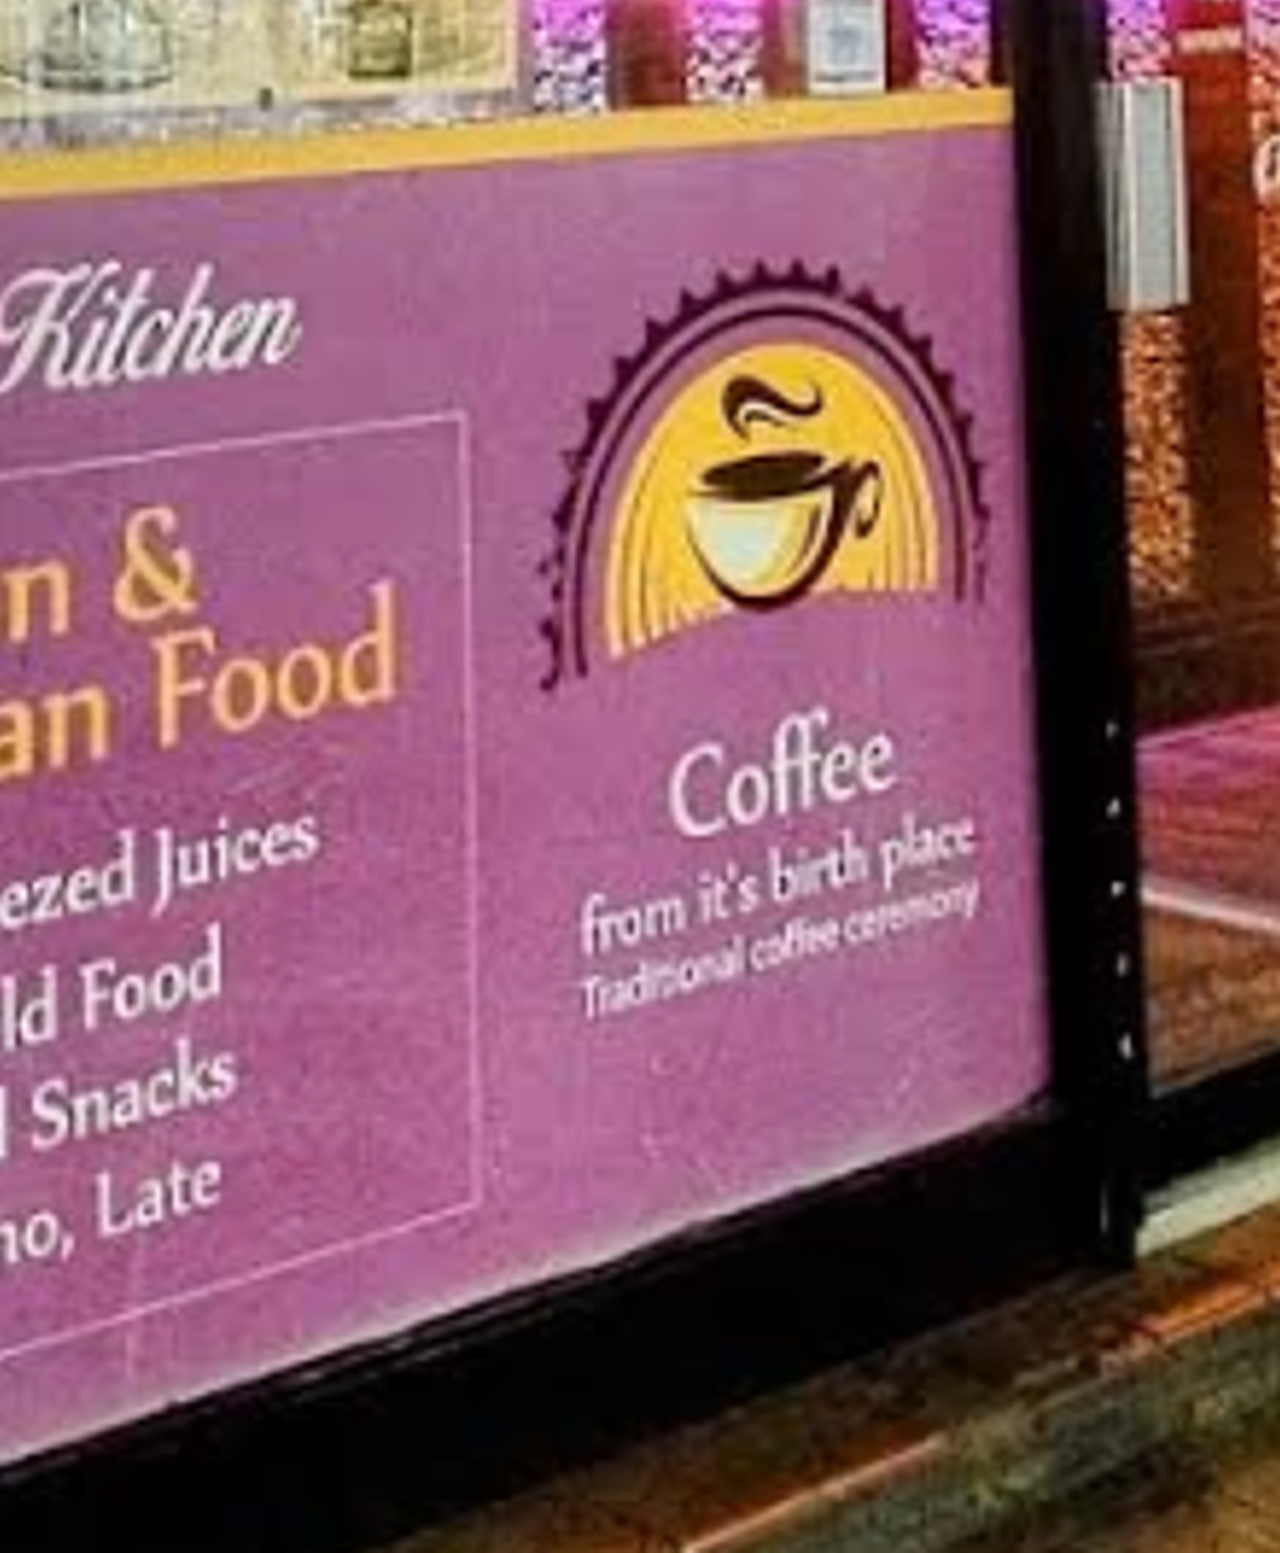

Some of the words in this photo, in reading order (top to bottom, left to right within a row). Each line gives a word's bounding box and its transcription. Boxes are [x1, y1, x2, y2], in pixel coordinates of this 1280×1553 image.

[112, 503, 198, 627] &
[151, 580, 401, 750] Food
[668, 706, 900, 838] Coffee
[154, 809, 320, 918] Juices
[580, 892, 688, 956] from
[698, 863, 759, 924] it's
[769, 830, 870, 905] birth
[879, 812, 976, 891] place
[81, 923, 224, 1031] Food
[580, 937, 748, 1021] Traditional
[749, 915, 842, 971] coffee
[843, 880, 981, 941] ceremony
[29, 1036, 237, 1151] Snacks
[95, 1155, 223, 1239] Late
